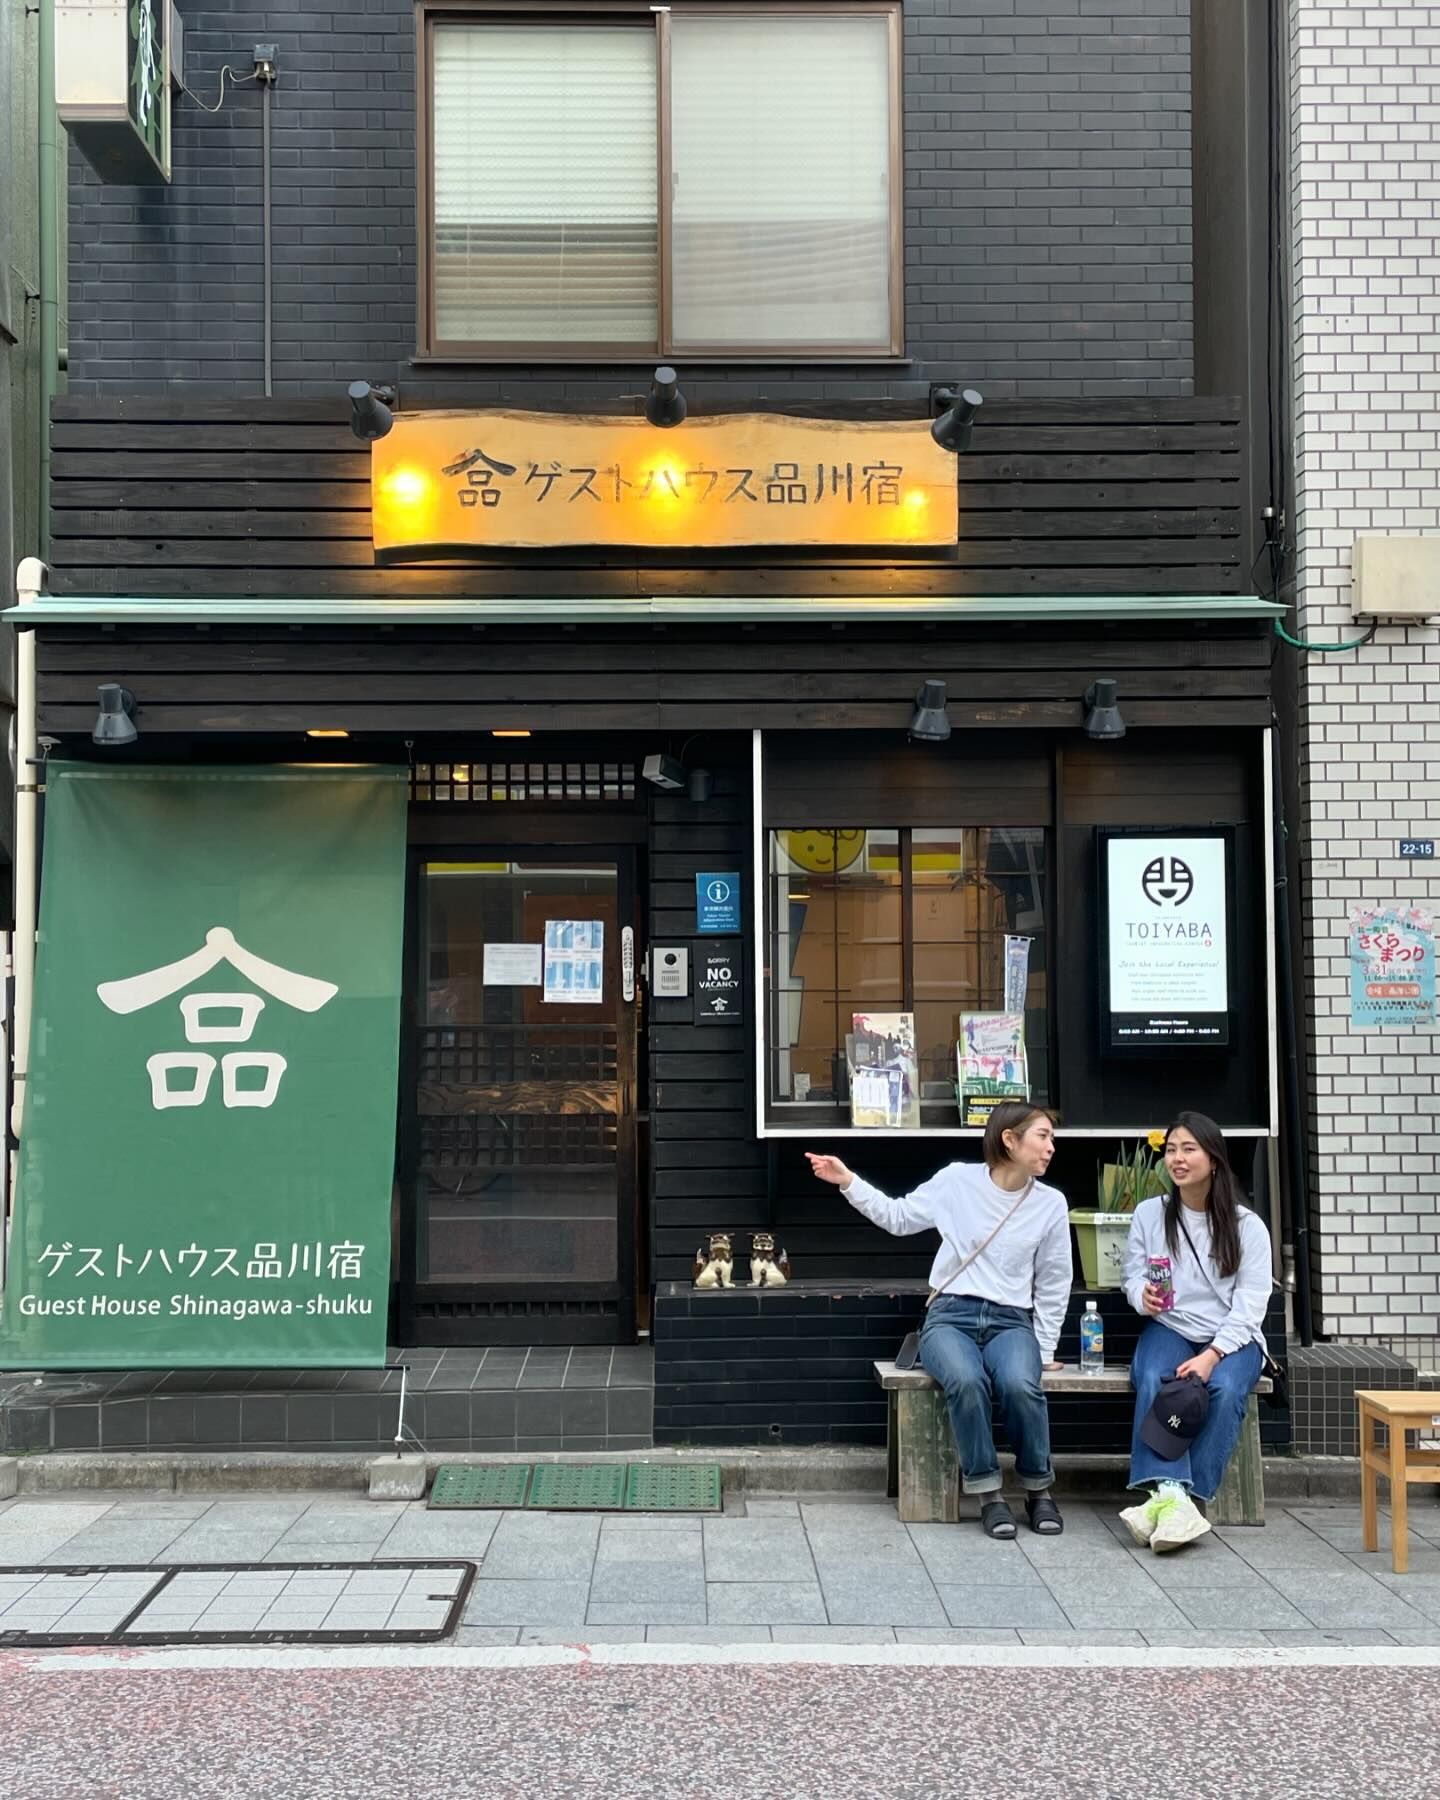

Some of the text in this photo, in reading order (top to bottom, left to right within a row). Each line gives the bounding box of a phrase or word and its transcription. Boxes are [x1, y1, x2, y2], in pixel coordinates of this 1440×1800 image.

[523, 460, 904, 506] ゲストハウス品川宿
[1402, 843, 1432, 855] 22-15
[1125, 922, 1212, 939] TOIYABA
[1359, 933, 1400, 949] さくら
[1380, 946, 1425, 962] まつり
[707, 967, 732, 981] NO
[699, 980, 739, 989] VACANCY
[37, 1240, 366, 1280] ゲストハウス品川宿
[19, 1294, 373, 1321] Guest House Shinagawa-shuku
